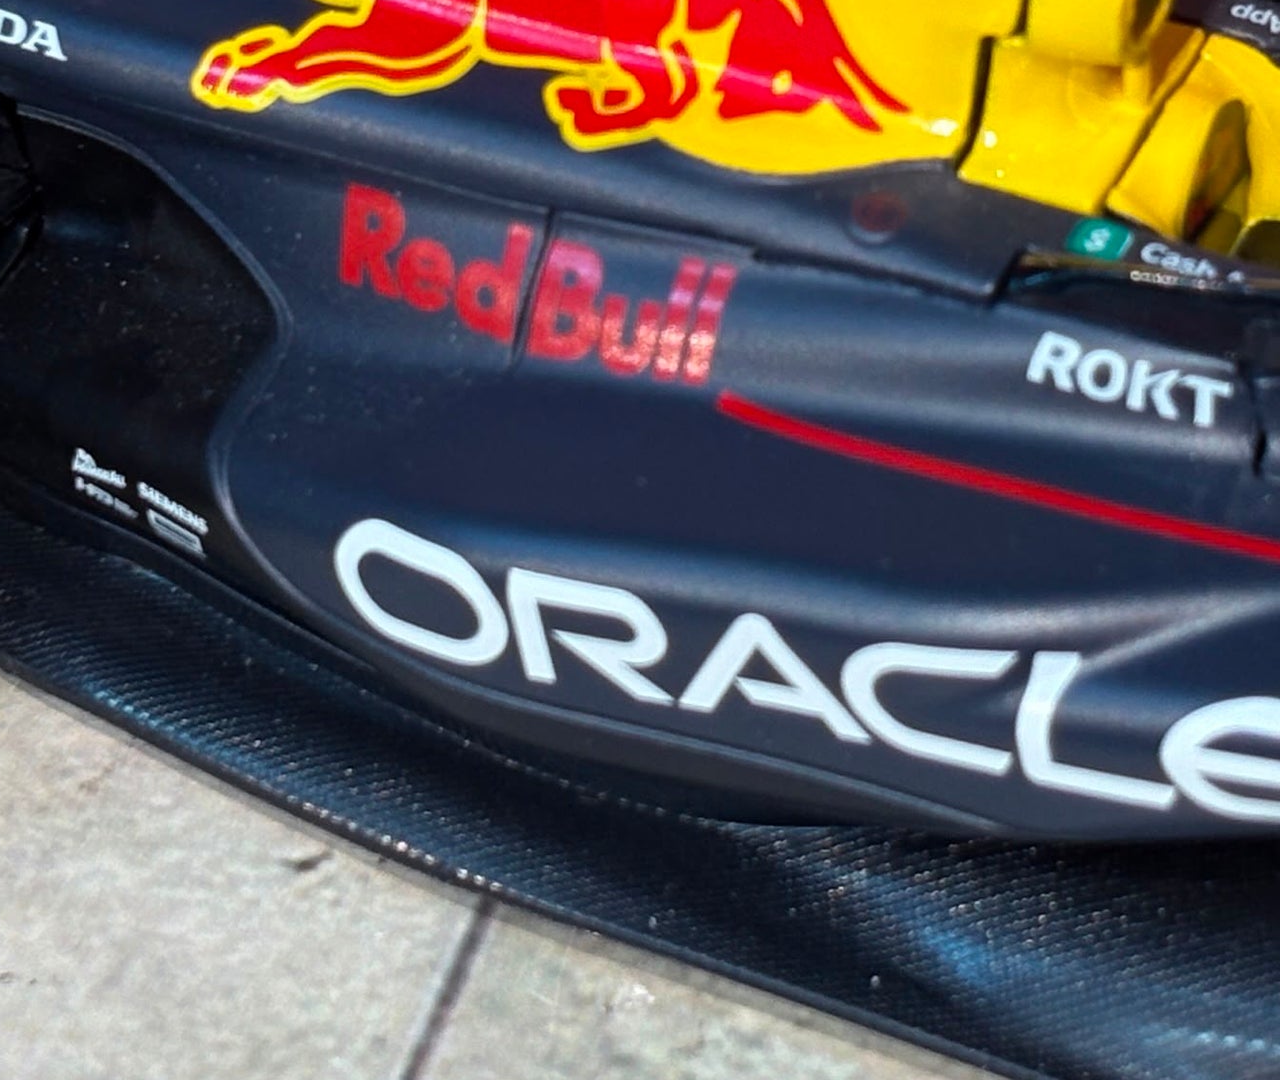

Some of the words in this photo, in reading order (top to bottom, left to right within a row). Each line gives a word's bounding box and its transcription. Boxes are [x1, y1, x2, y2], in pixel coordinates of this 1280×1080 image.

[339, 180, 535, 345] Red
[526, 238, 739, 389] Bull
[1027, 330, 1234, 425] ROKT
